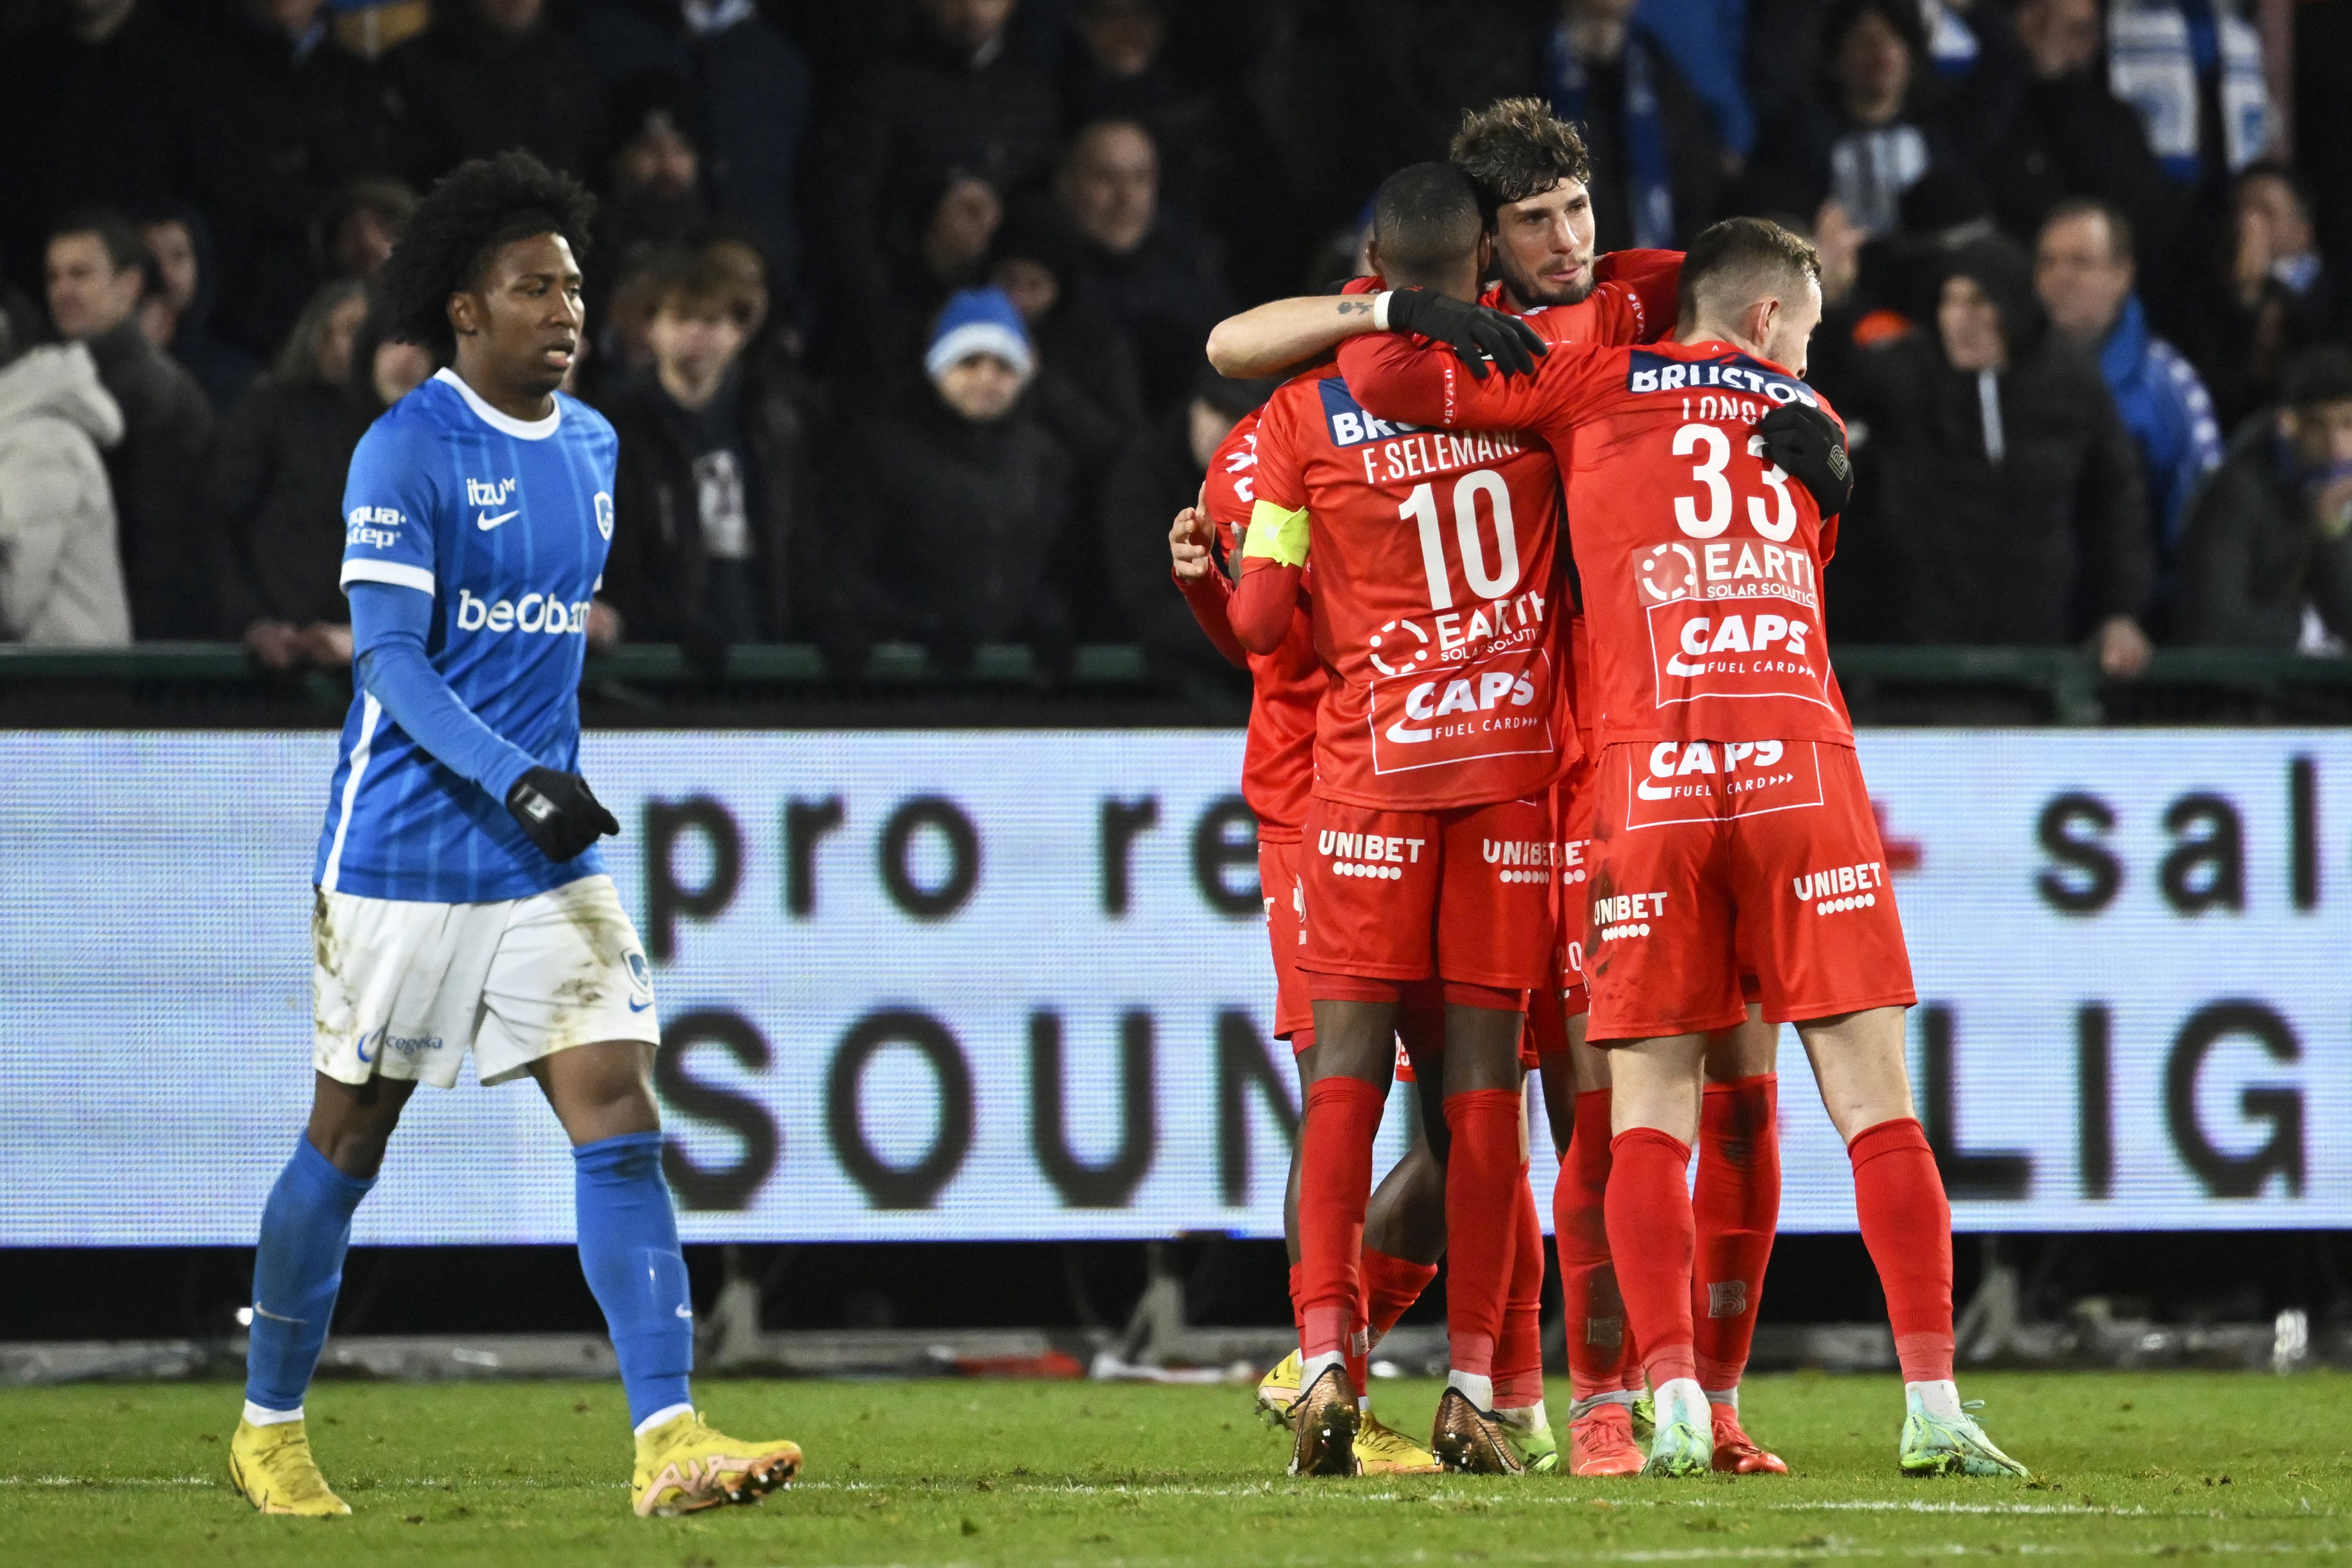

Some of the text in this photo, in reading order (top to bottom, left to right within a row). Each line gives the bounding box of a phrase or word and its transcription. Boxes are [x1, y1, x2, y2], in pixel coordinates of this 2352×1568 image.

[1672, 423, 1797, 542] 33
[1398, 469, 1520, 611] 10
[1707, 584, 1758, 598] SOLAR
[1680, 614, 1809, 656] CAPS
[1708, 661, 1796, 674] FUEL CARD
[1405, 668, 1535, 722] CAPS
[1435, 717, 1520, 739] FUEL CARD
[1674, 776, 1766, 798] FUEL CARD
[1318, 830, 1425, 863] UNIBET
[642, 791, 983, 965] pro
[1793, 862, 1882, 901] UNIBET
[1594, 891, 1667, 926] UNIBET
